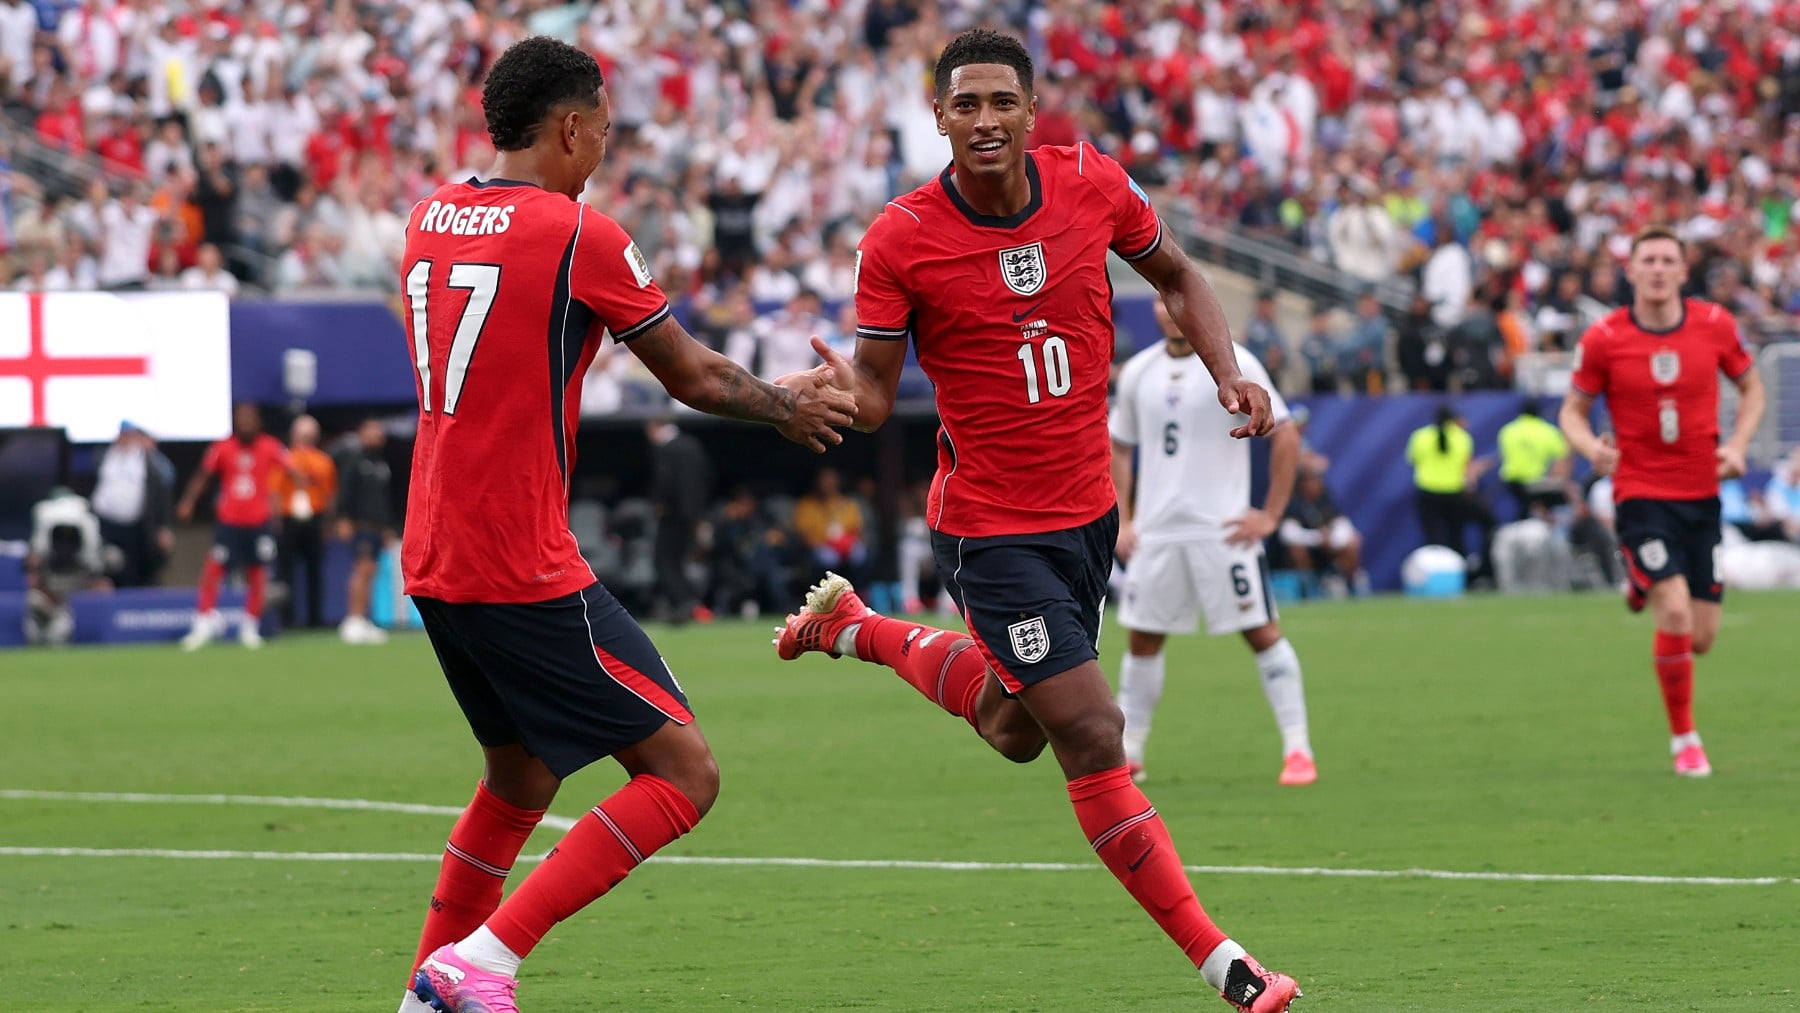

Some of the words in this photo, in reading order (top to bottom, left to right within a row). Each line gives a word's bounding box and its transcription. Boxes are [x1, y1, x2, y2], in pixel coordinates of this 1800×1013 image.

[420, 200, 516, 236] ROGERS
[406, 259, 502, 416] 17
[1020, 319, 1048, 331] PANAMA
[1016, 335, 1072, 404] 10
[1164, 421, 1180, 456] 6
[1230, 563, 1250, 597] 6
